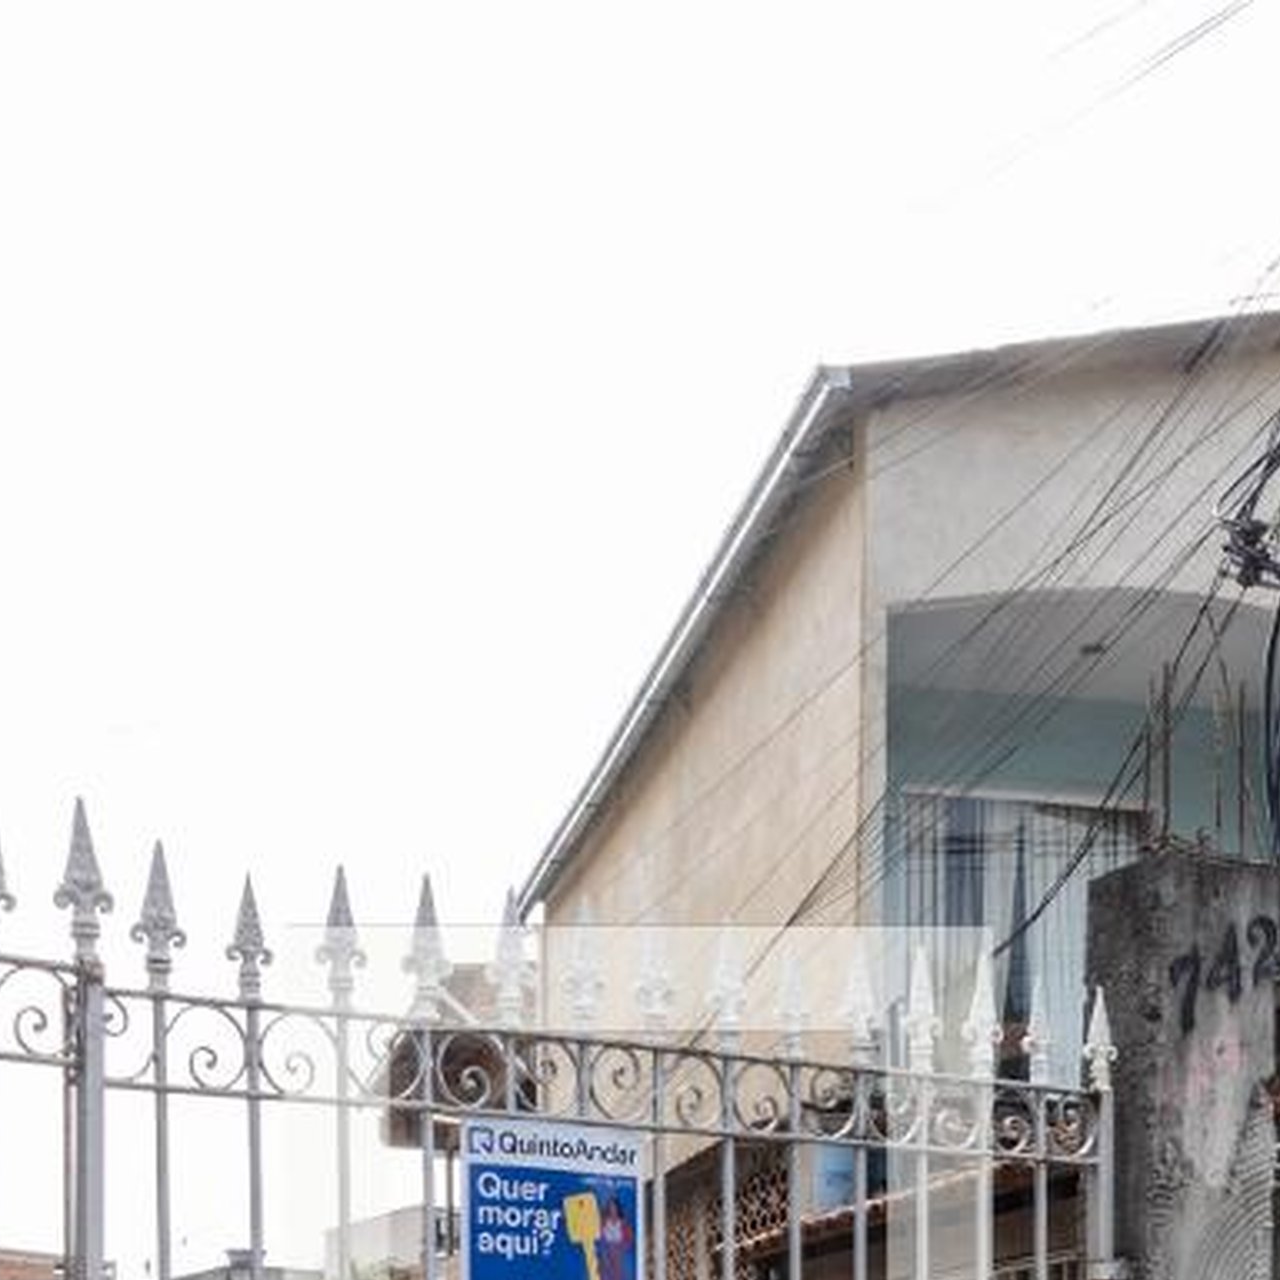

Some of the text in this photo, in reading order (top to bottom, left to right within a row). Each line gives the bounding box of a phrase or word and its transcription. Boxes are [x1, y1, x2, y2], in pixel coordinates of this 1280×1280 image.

[499, 1131, 637, 1165] QuintoAndar
[479, 1172, 550, 1202] Quer
[478, 1205, 562, 1230] morar
[478, 1230, 556, 1260] aqui?
